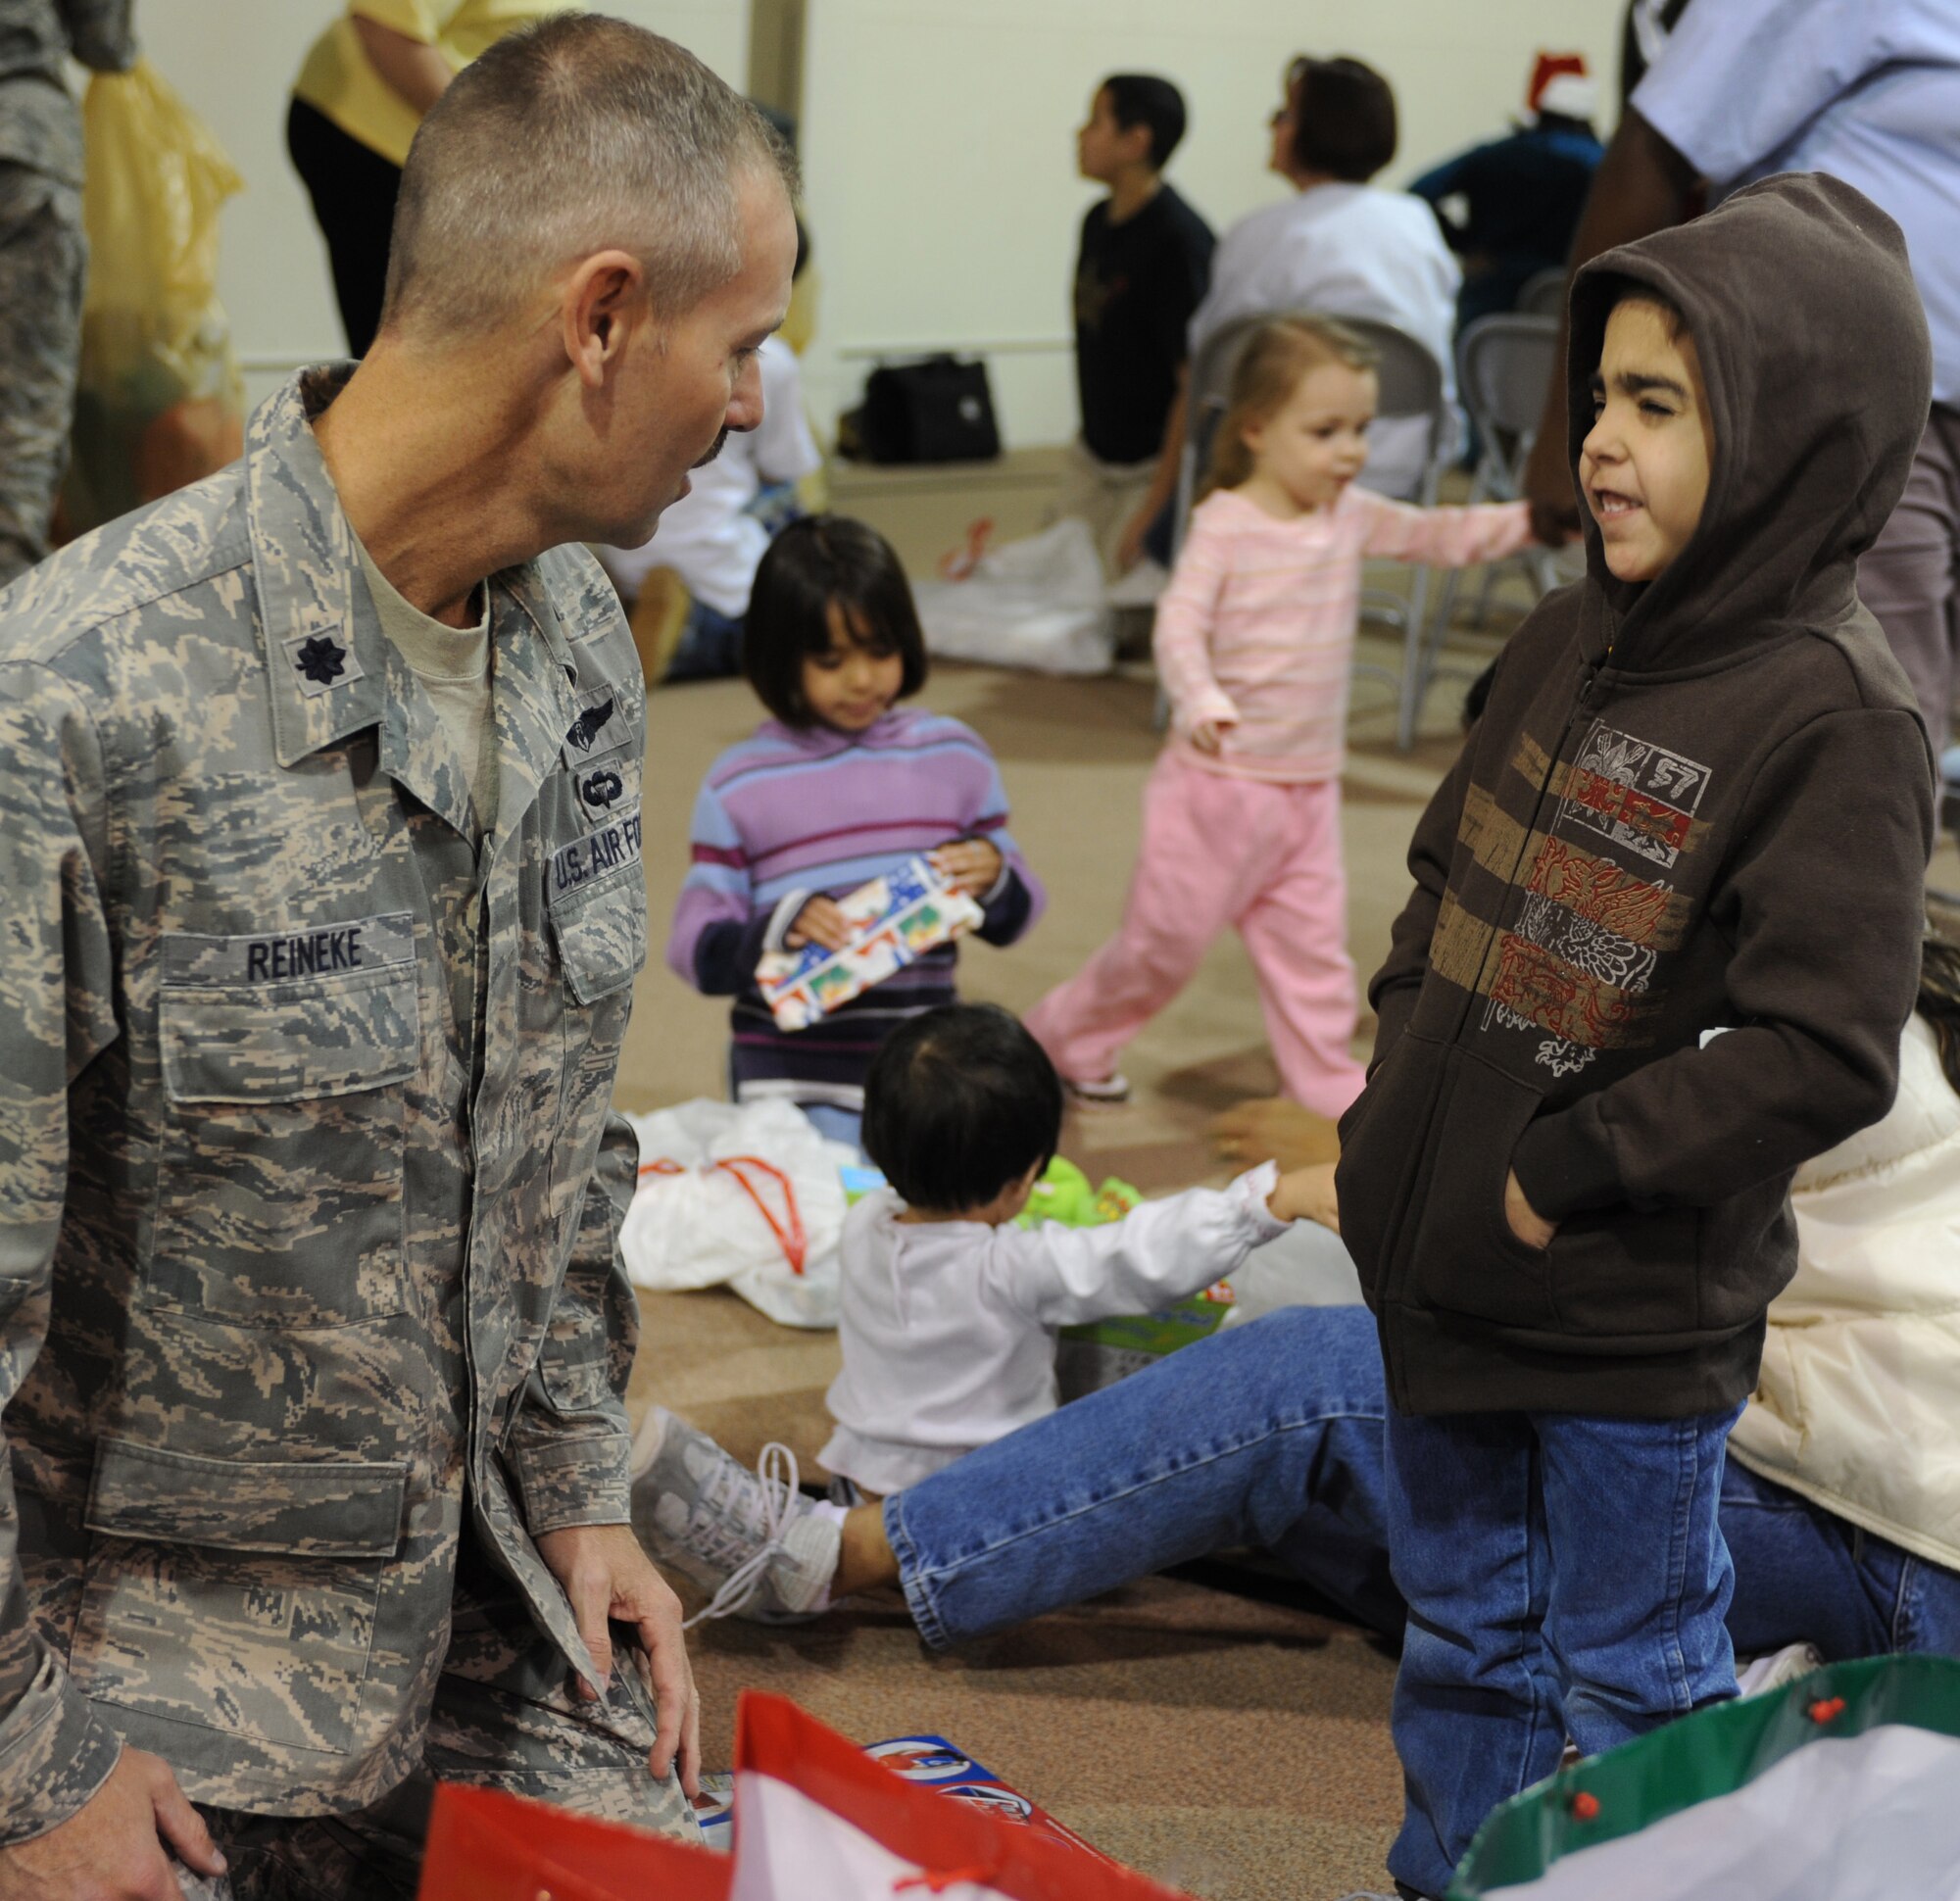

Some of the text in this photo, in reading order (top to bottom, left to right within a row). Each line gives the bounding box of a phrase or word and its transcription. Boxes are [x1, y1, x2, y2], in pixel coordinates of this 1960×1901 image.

[1647, 757, 1699, 800] 57
[555, 847, 589, 890] U.S.
[590, 828, 626, 874] AIR
[248, 928, 362, 980] REINEKE
